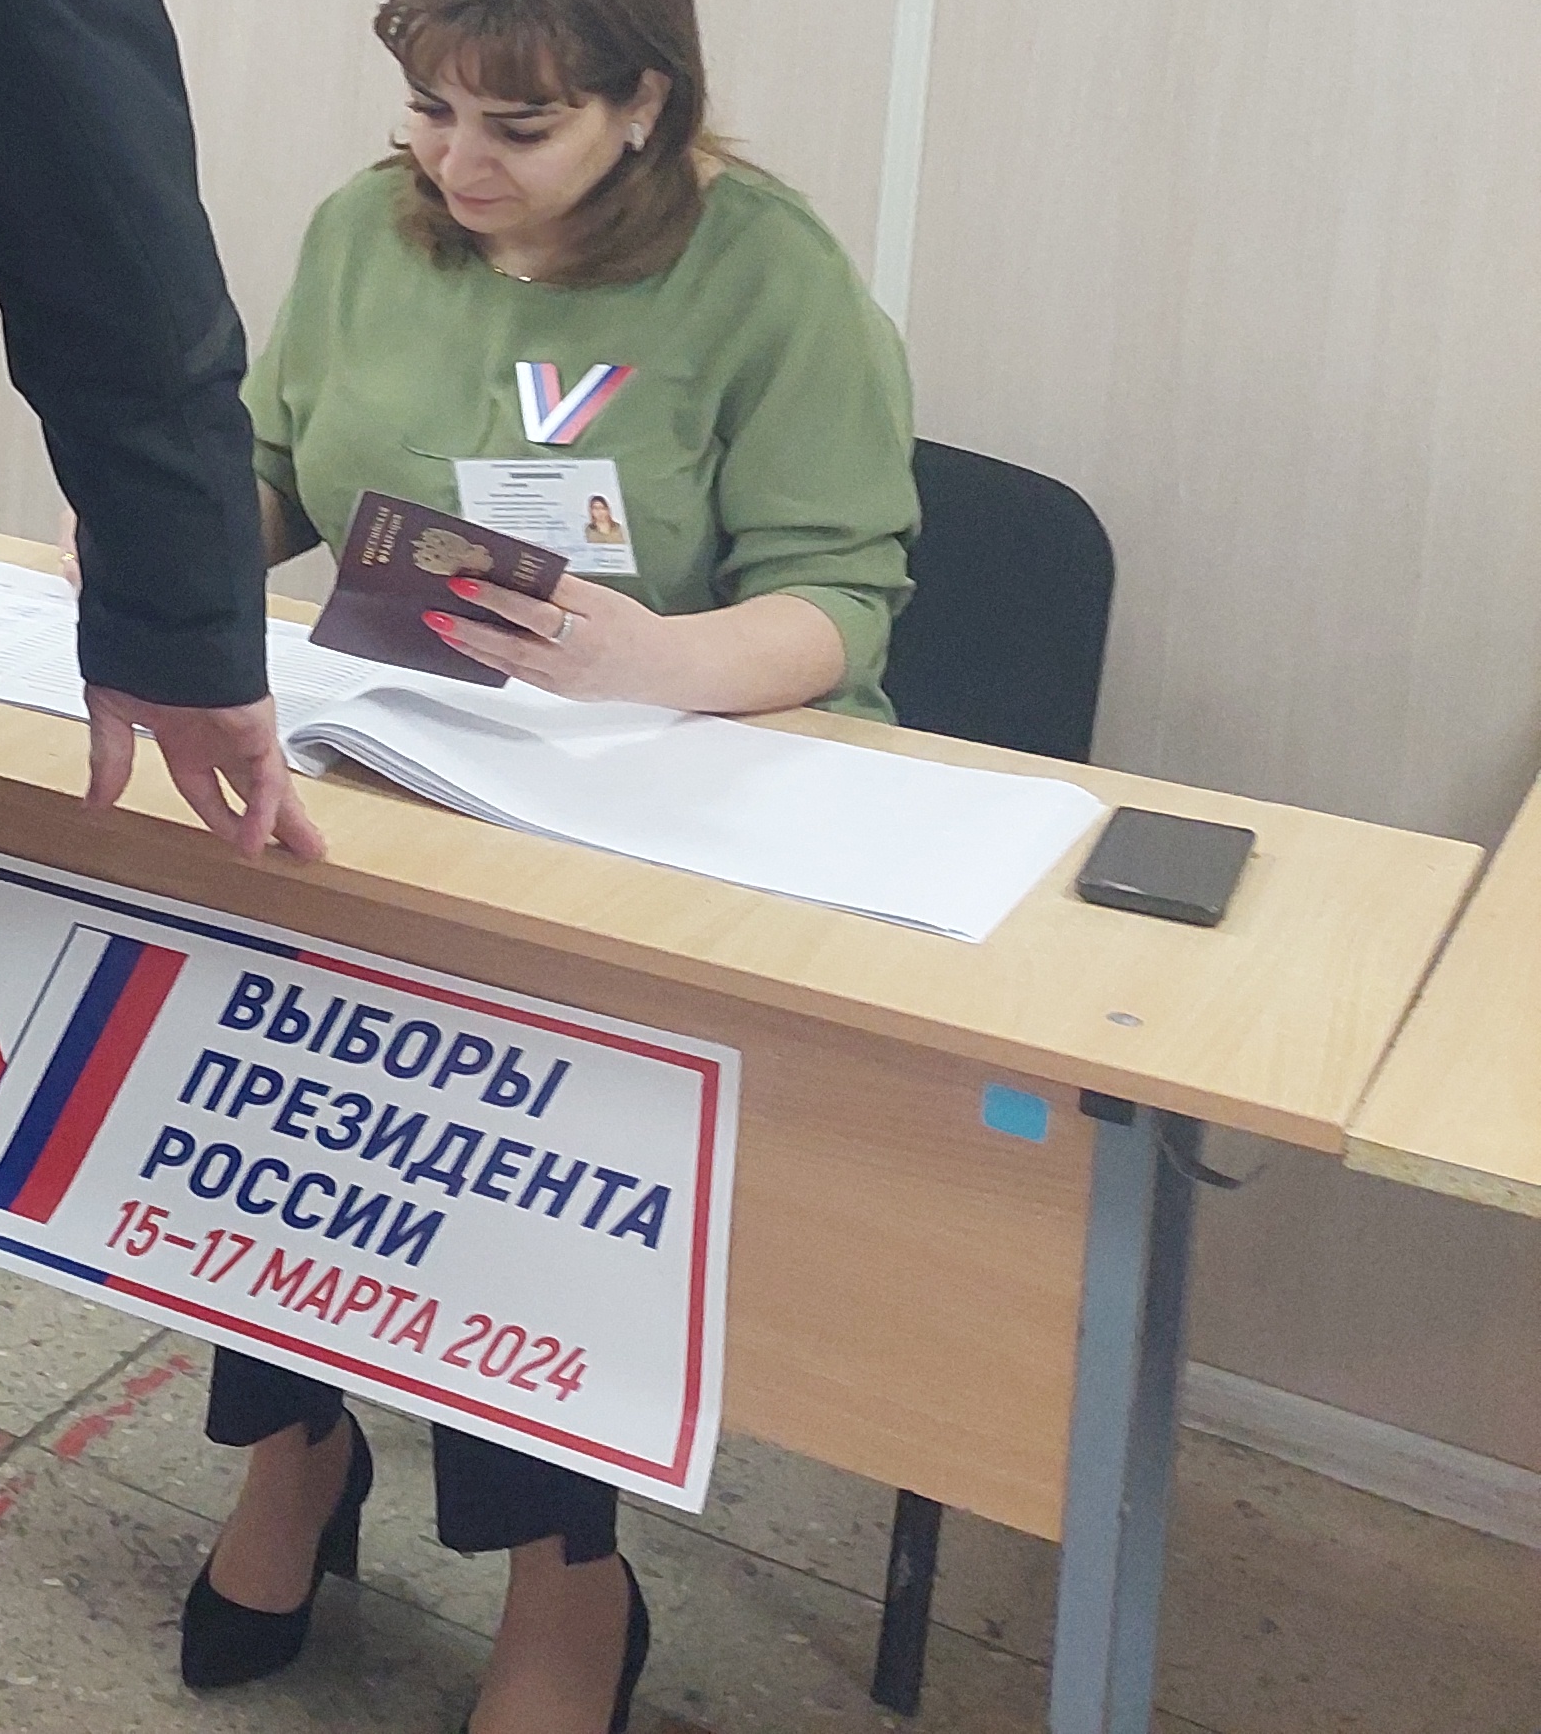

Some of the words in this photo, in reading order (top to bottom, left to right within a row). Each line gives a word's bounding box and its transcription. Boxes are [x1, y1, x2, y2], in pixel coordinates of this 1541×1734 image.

[216, 970, 573, 1120] ВЫБОРЫ
[138, 1124, 447, 1268] РОССИИ
[177, 1047, 672, 1251] ПРЕЗИДЕНТА
[248, 1247, 440, 1355] МАРТА
[439, 1313, 588, 1402] 2024
